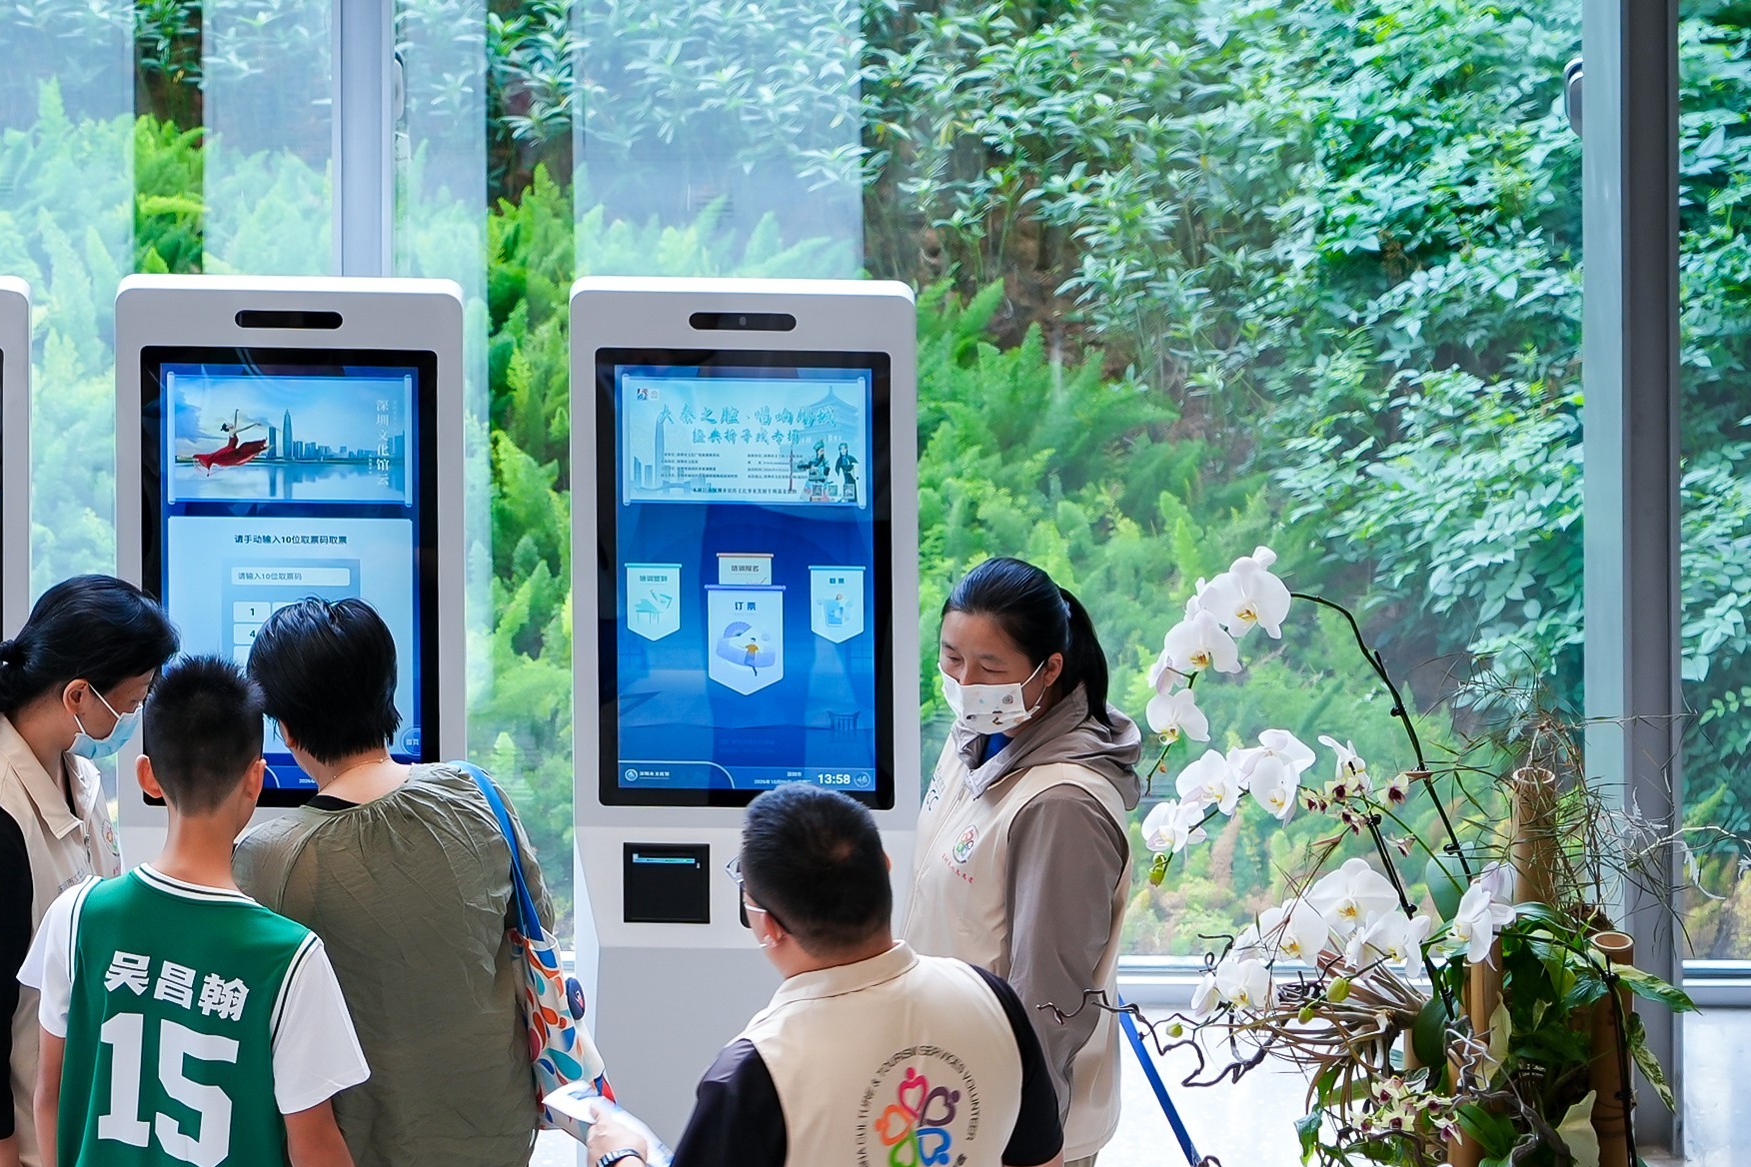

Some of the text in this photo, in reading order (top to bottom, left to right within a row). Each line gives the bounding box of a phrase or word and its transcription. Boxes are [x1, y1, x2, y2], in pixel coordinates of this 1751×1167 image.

[234, 534, 347, 545] 请手动输入10位取票码取票
[238, 572, 302, 580] 请输入10位取票码
[735, 601, 756, 611] 订票
[249, 607, 255, 616] 1
[249, 629, 256, 638] 4
[817, 773, 851, 785] 13:58
[104, 950, 250, 1022] 吴昌翰
